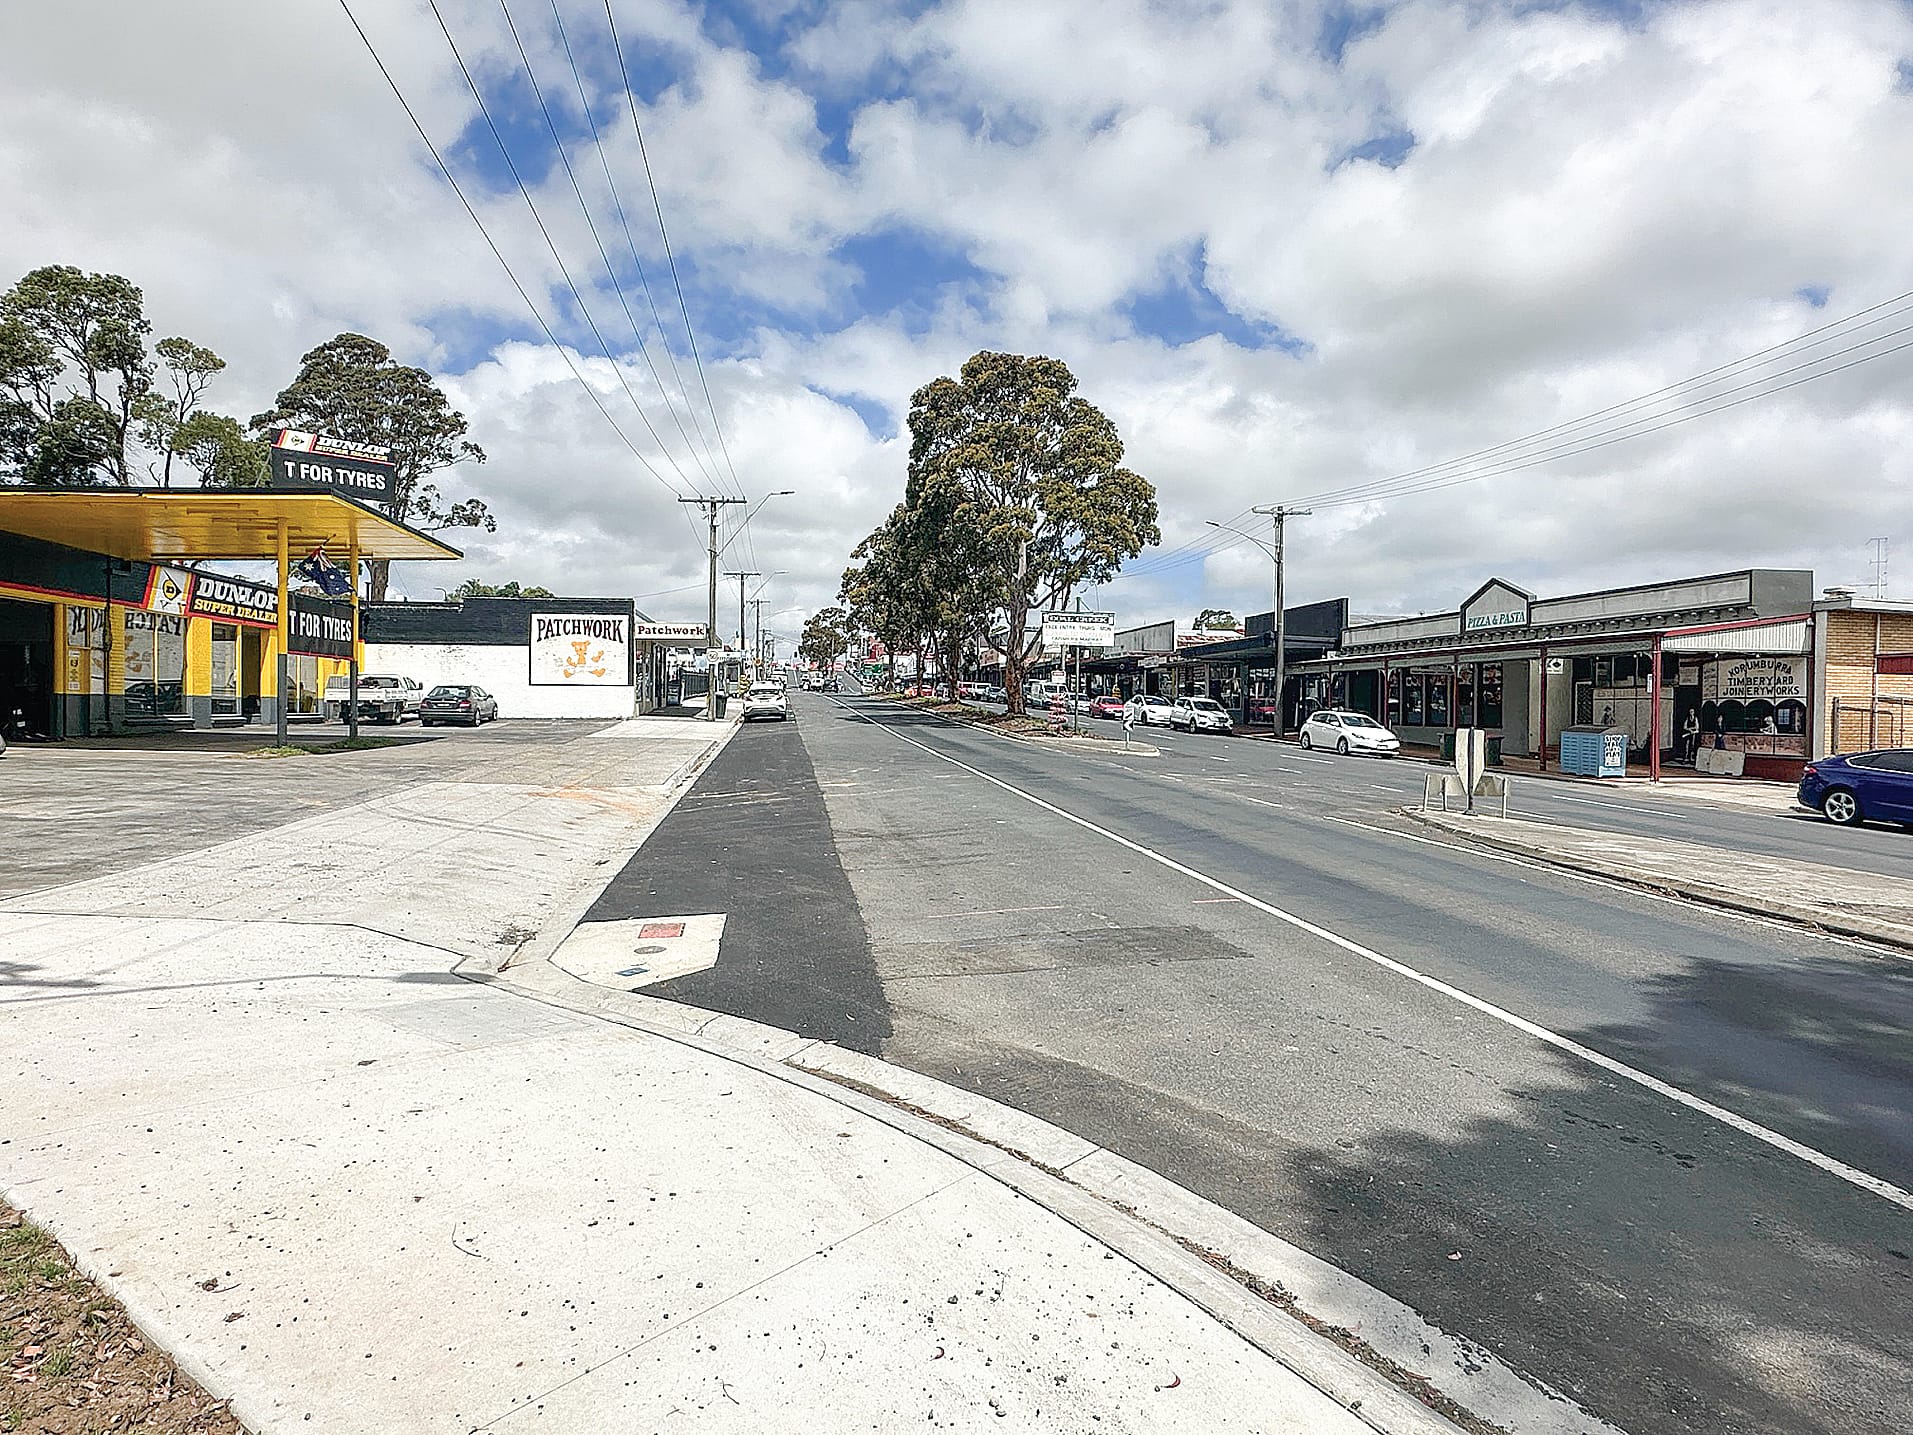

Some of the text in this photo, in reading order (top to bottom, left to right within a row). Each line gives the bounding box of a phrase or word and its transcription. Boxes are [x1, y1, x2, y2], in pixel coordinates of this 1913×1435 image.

[316, 436, 391, 456] DUNLOP
[284, 460, 386, 490] T FOR TYRES
[196, 577, 279, 611] DUNLOP
[193, 599, 278, 623] SUPER DEALER
[1467, 611, 1526, 629] PIZZA & PASTA
[289, 610, 352, 642] T FOR TYRES
[536, 618, 624, 644] PATCHWORK
[637, 625, 705, 636] Patchwork
[1728, 660, 1792, 677] KORUMBURRA
